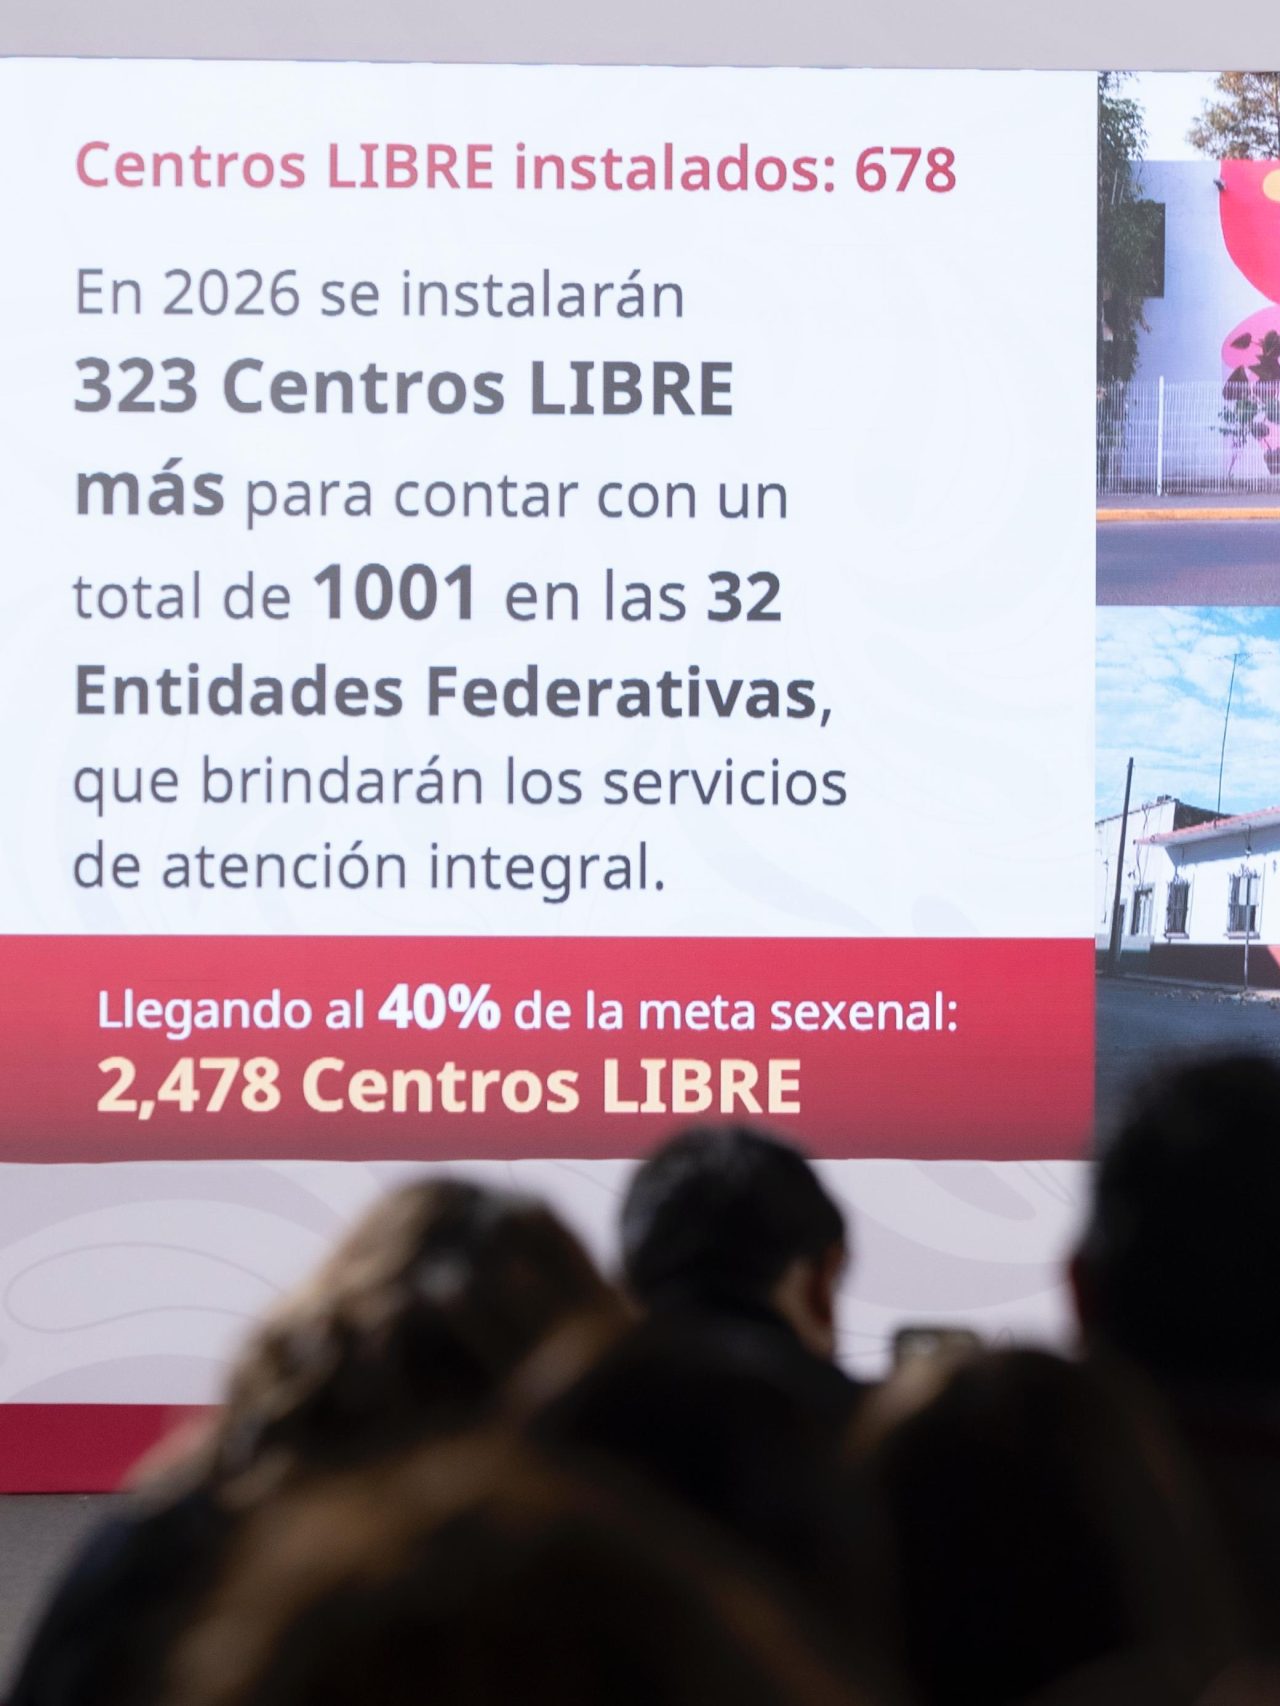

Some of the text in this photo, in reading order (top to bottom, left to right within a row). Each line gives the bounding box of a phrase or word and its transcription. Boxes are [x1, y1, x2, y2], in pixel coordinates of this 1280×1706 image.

[76, 140, 957, 194] Centros LIBRE instalados: 678
[77, 268, 684, 319] En 2026 se instalarán
[74, 356, 733, 416] 323 Centros LIBRE
[77, 457, 788, 531] más para contar con un
[73, 562, 782, 623] total de 1001 en las 32
[76, 662, 832, 728] Entidades Federativas,
[74, 754, 847, 818] que brindarán los servicios
[73, 838, 665, 905] de atención integral.
[98, 982, 958, 1041] Llegando al 40% de la meta sexenal:
[96, 1055, 801, 1121] 2,478 Centros LIBRE
